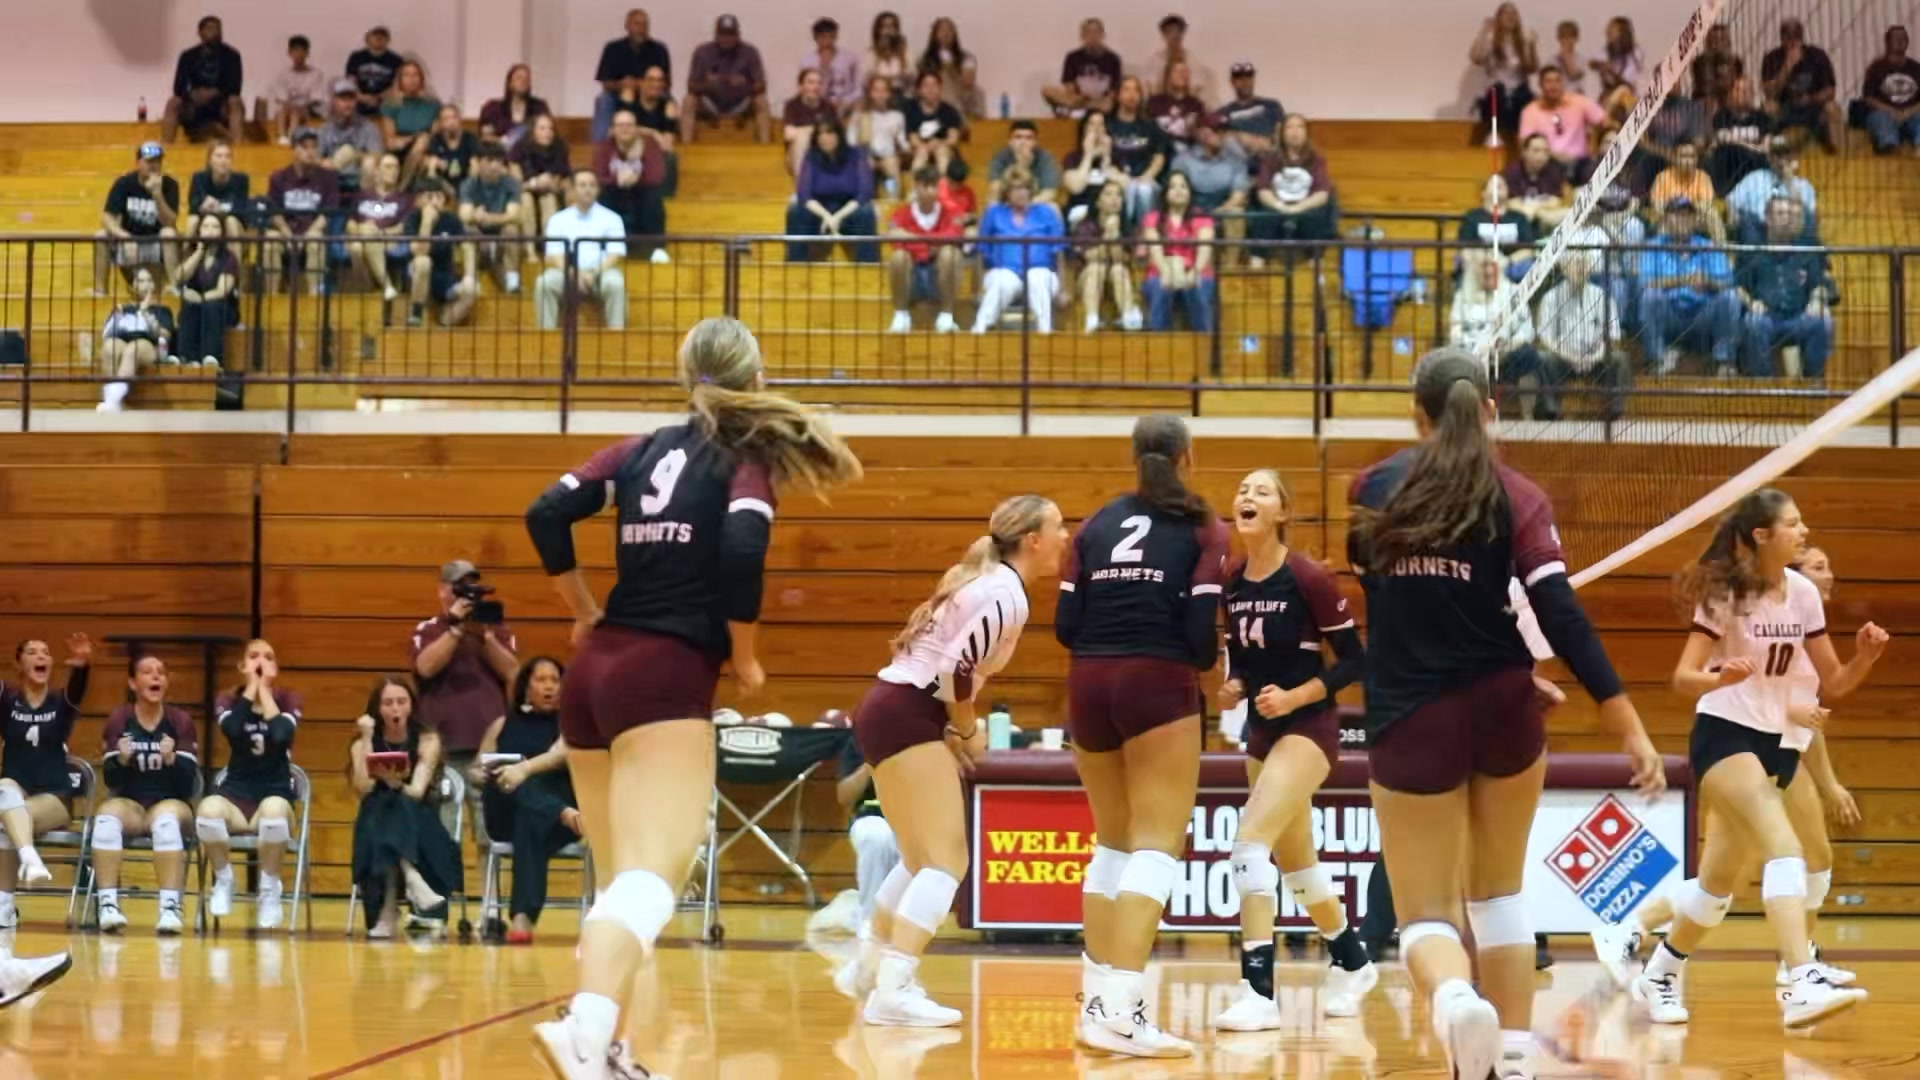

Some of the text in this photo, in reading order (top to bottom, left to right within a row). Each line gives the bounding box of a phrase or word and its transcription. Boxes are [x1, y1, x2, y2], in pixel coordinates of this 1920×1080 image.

[640, 448, 687, 515] 9
[1110, 514, 1153, 563] 2
[1390, 556, 1472, 582] ORNETS
[1239, 616, 1265, 649] 14
[1765, 642, 1795, 677] 10
[25, 724, 40, 747] 4
[250, 732, 265, 756] 3
[136, 752, 163, 773] 10
[986, 859, 1087, 884] FARG
[1584, 834, 1657, 908] DOMINO'S
[1599, 879, 1648, 924] PIZZA
